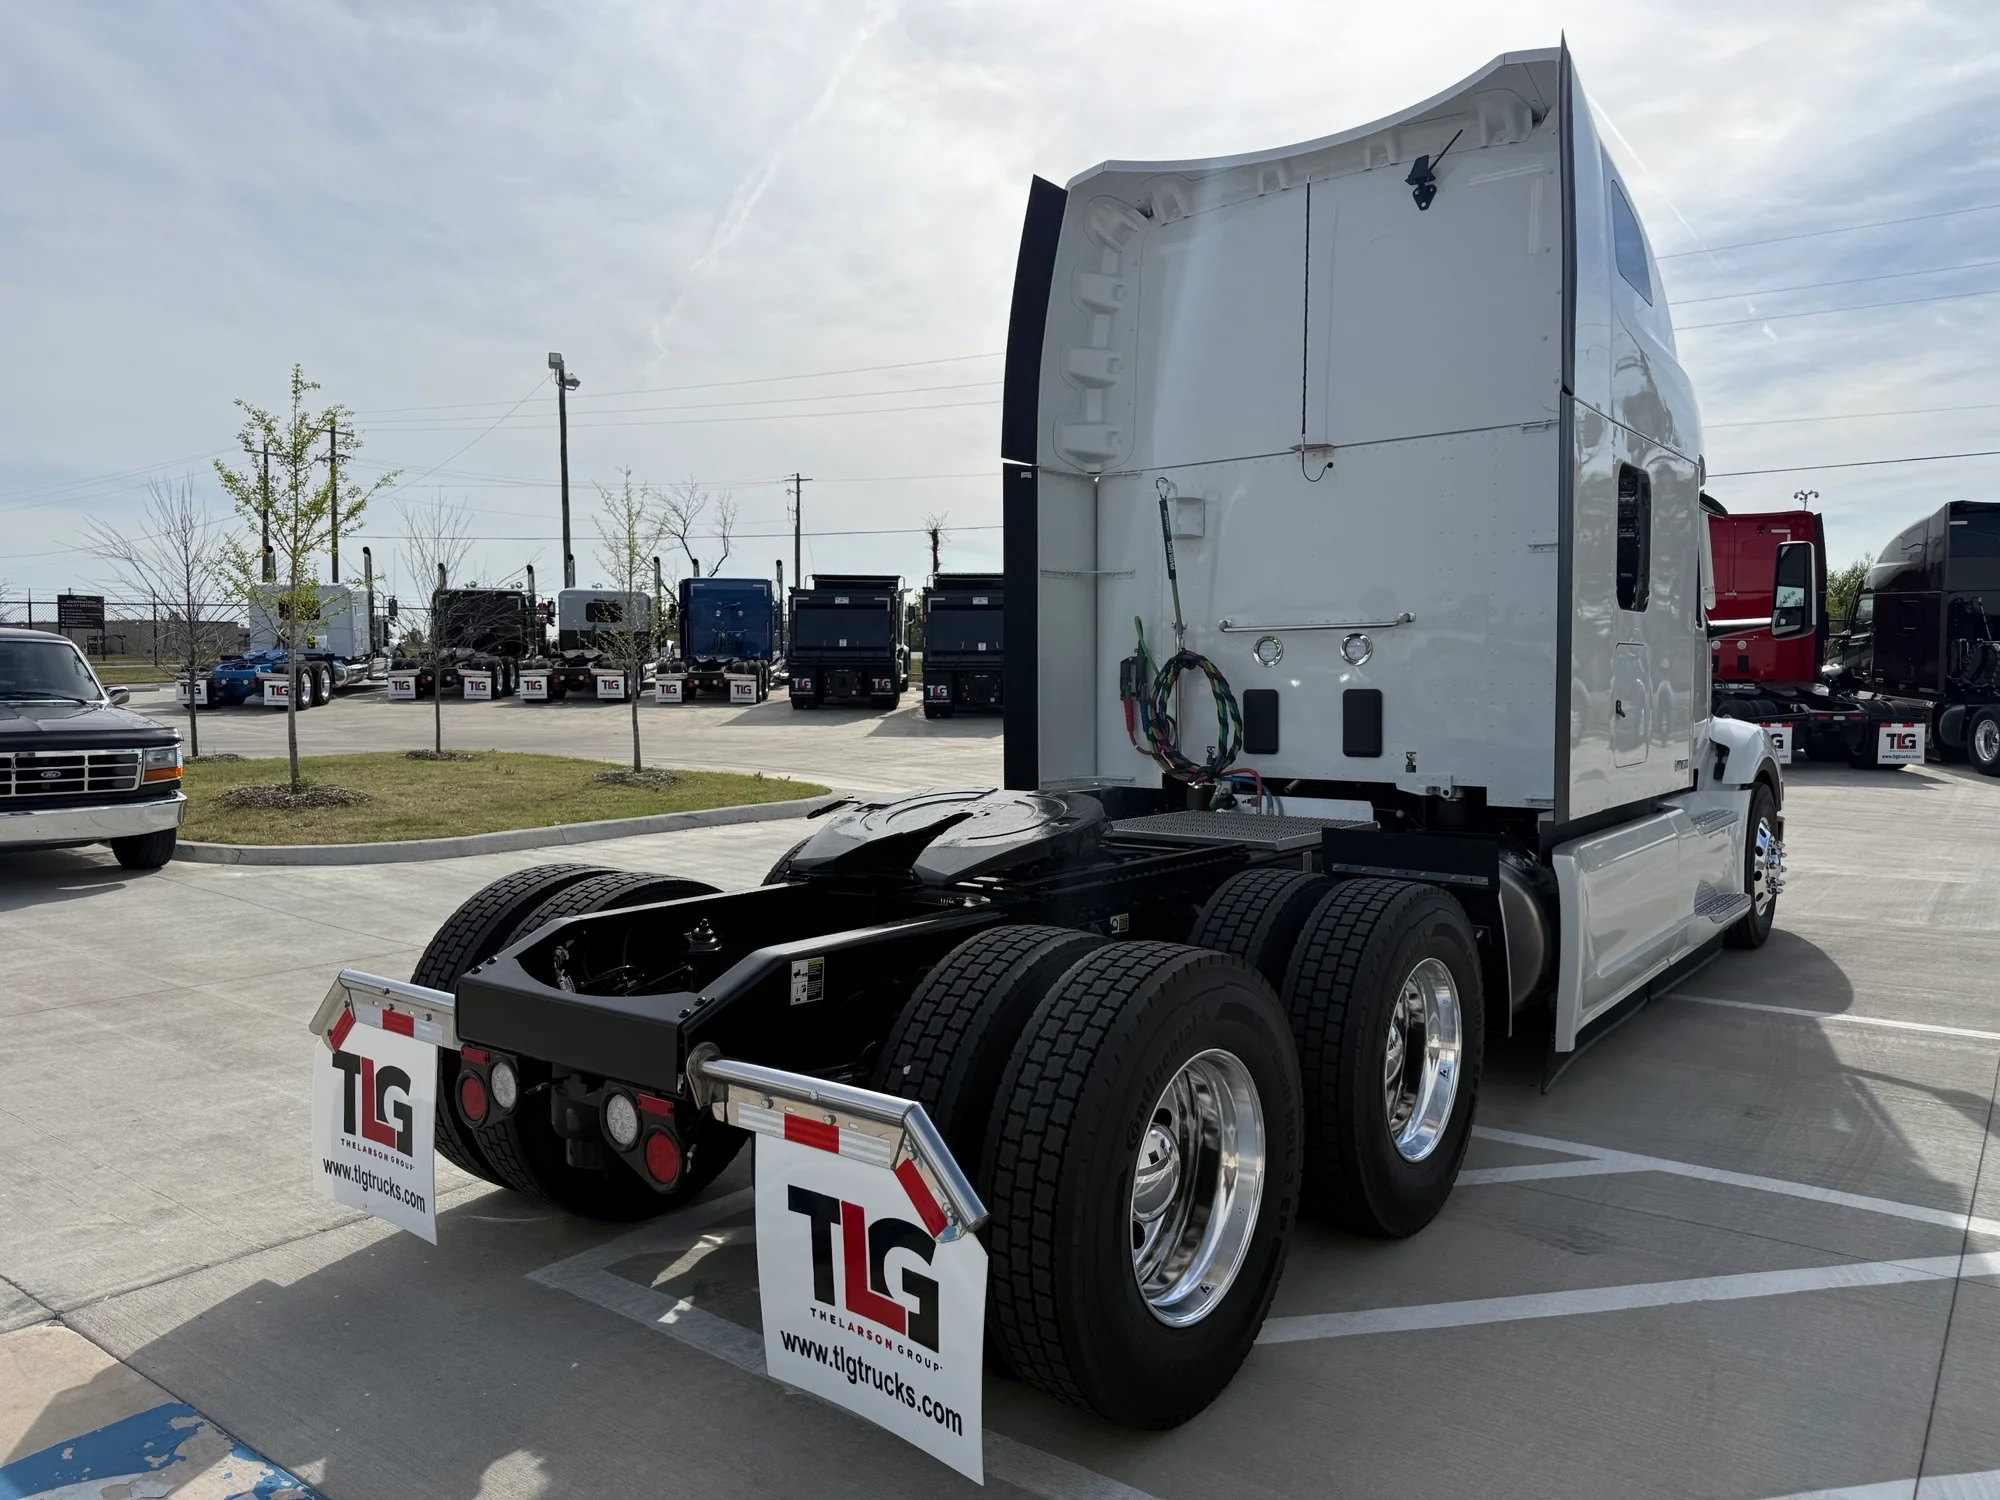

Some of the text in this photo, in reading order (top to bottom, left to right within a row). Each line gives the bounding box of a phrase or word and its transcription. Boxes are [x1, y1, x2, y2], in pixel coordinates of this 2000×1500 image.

[392, 681, 410, 690] TLG
[468, 681, 486, 691] TLG
[524, 681, 542, 690] TLG
[602, 680, 620, 690] TLG
[792, 678, 812, 688] TLG
[872, 678, 892, 689] TLG
[180, 684, 202, 694] TG
[269, 685, 289, 696] TLG
[660, 684, 676, 694] TLG
[734, 684, 752, 694] TLG
[927, 684, 948, 697] TLG
[1886, 733, 1916, 749] TLG
[332, 1050, 412, 1157] TLG
[323, 1157, 426, 1214] www.tlgtrucks.com
[787, 1184, 939, 1354] TLG
[897, 1344, 940, 1372] GROUP
[780, 1330, 963, 1437] www.tlgtrucks.com
